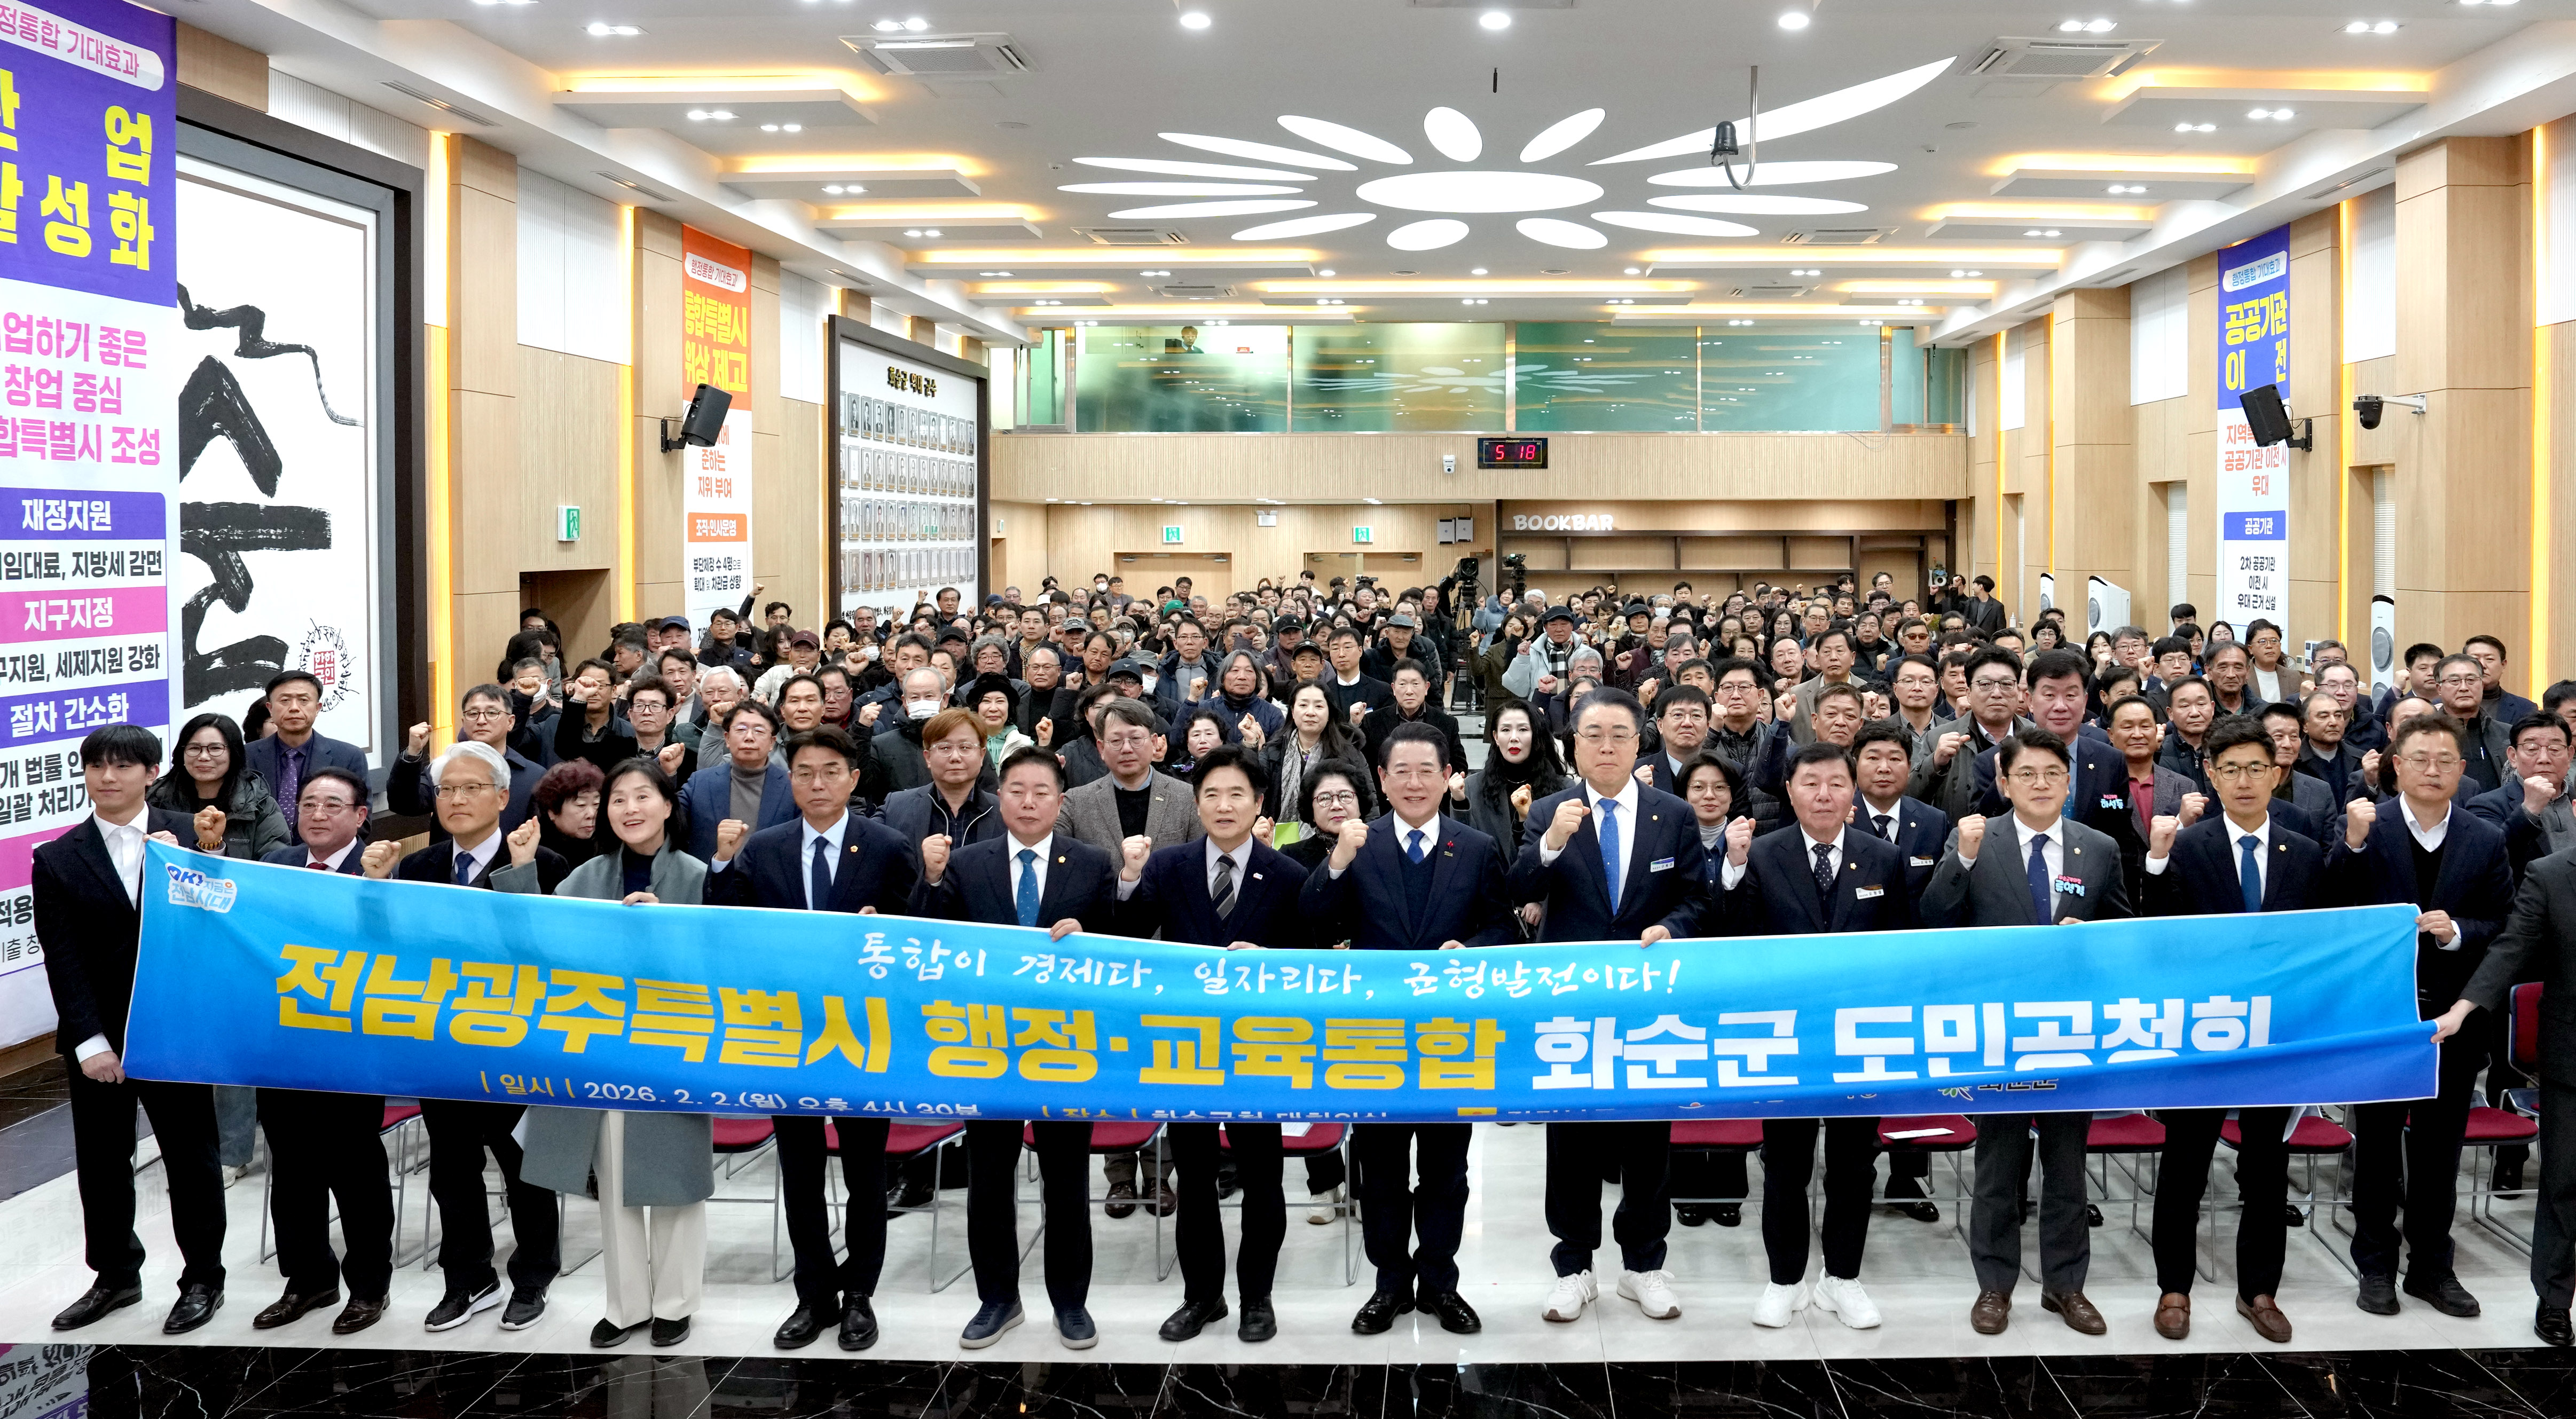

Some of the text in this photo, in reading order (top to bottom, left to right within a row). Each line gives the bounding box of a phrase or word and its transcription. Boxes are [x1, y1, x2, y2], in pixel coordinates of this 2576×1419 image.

[67, 31, 140, 78] 기대효과
[691, 259, 739, 288] 행정통합 기대효과
[2232, 258, 2281, 287] 행정통합 기대효과
[685, 290, 747, 348] 통합특별시
[2225, 289, 2287, 346] 공공기관
[0, 312, 147, 369] 업하기 좋은
[685, 340, 748, 392] 위상 제고
[4, 364, 122, 415] 창업 중심
[888, 366, 937, 398] 화순군 역대 군수
[112, 427, 160, 465] 조성
[702, 449, 726, 471] 준하는
[1496, 445, 1536, 460] 5 18
[2225, 445, 2287, 471] 공공기관 이전 시
[698, 476, 732, 498] 지위 부여
[2252, 475, 2268, 496] 우대
[22, 499, 112, 531] 재정지원
[1513, 514, 1614, 531] BOOKBAR
[2245, 517, 2273, 535] 공공기관
[0, 550, 162, 580] 임대료, 지방세 감면
[693, 557, 714, 572] 부단체장
[716, 557, 721, 571] 수
[2241, 556, 2275, 572] 2차 공공기관
[694, 577, 705, 592] 확대
[711, 576, 728, 590] 차관급
[729, 575, 741, 589] 상향
[2249, 575, 2268, 590] 이전 시
[25, 597, 113, 632] 지구지정
[2237, 593, 2250, 609] 우대
[2252, 594, 2264, 609] 근거
[56, 647, 123, 678] 세제지원
[128, 644, 160, 672] 강화
[10, 692, 129, 737] 절차 간소화
[25, 753, 62, 786] 법률
[171, 882, 231, 910] 전남시대
[858, 932, 1681, 1000] 통합이 경제다, 일자리다, 균형발전이다!
[276, 944, 891, 1073] 전남광주특별시
[921, 999, 1506, 1090] 행정·교육통합
[1532, 1009, 1800, 1090] 화순군
[499, 1073, 555, 1098] 일시
[584, 1082, 666, 1103] 2026.
[673, 1089, 703, 1105] 2.
